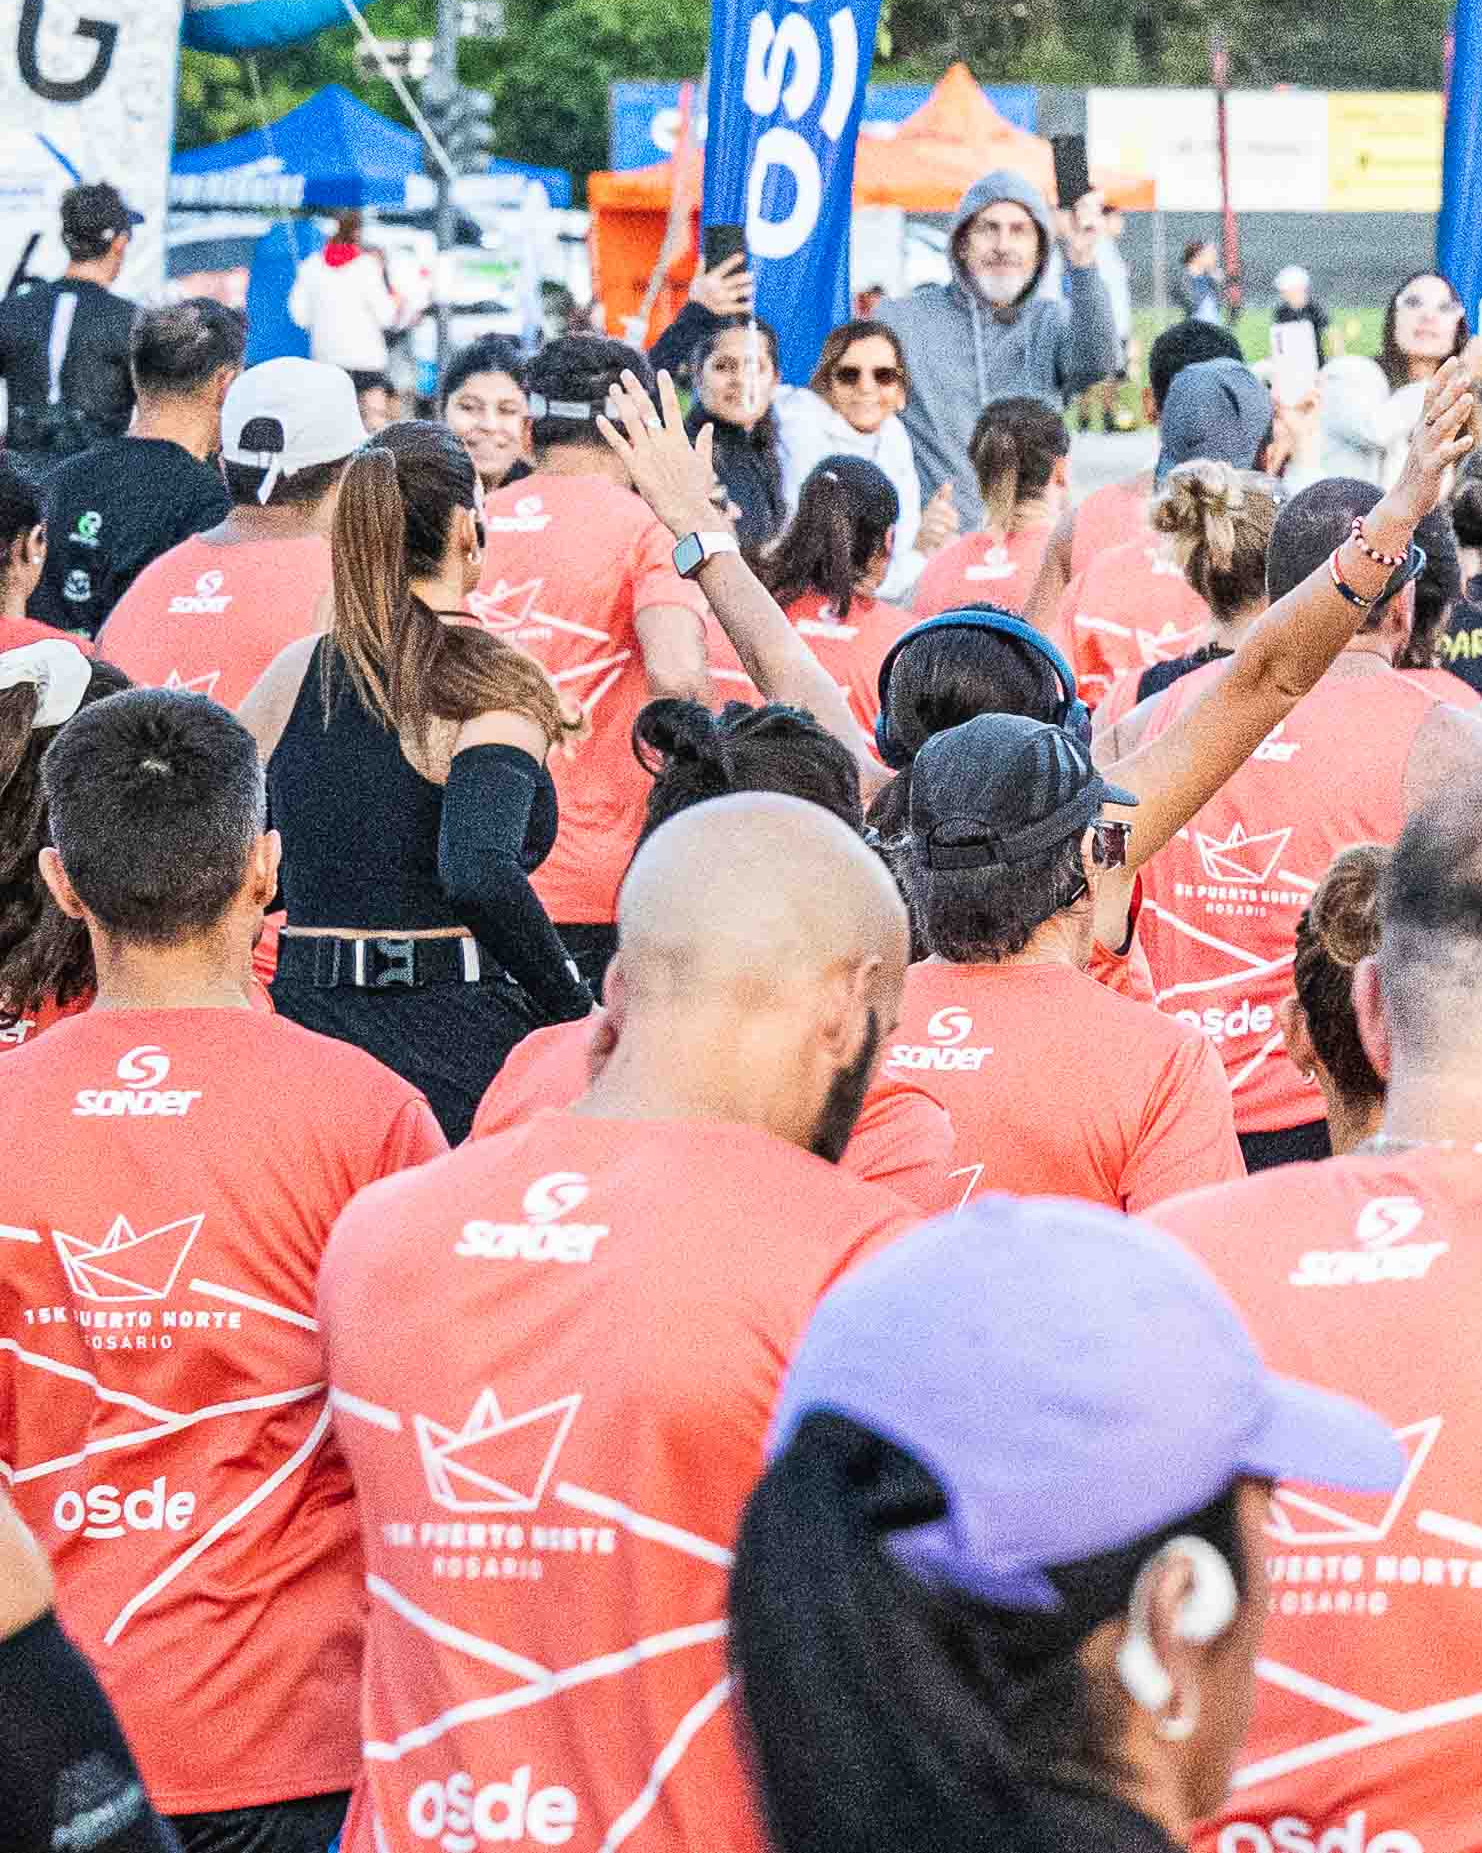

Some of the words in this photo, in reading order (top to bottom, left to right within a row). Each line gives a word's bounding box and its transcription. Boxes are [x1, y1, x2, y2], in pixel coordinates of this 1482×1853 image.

[23, 1307, 68, 1325] 15K
[73, 1309, 152, 1329] UERTO
[163, 1310, 242, 1330] NORTE
[53, 1475, 197, 1540] osde
[1265, 1554, 1363, 1583] UERTO
[408, 1763, 577, 1851] osde
